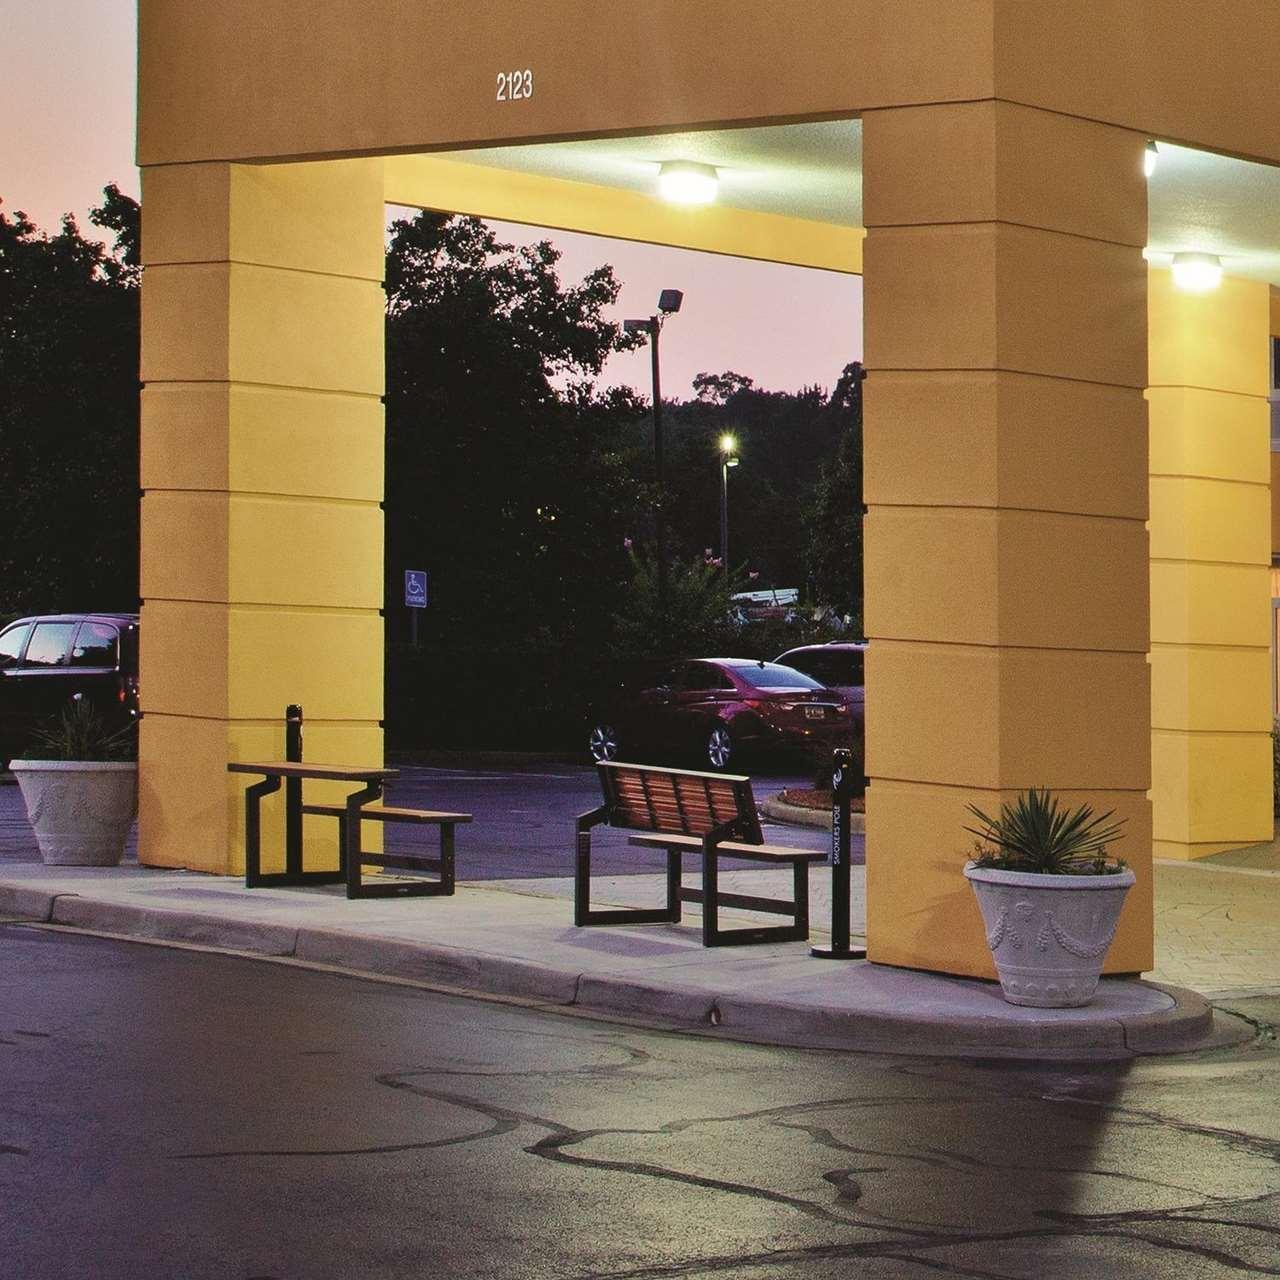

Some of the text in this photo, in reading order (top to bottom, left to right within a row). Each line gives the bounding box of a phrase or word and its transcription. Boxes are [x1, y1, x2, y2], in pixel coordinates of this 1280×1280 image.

[496, 69, 533, 101] 2123
[833, 805, 841, 865] SMOKERS POLE
